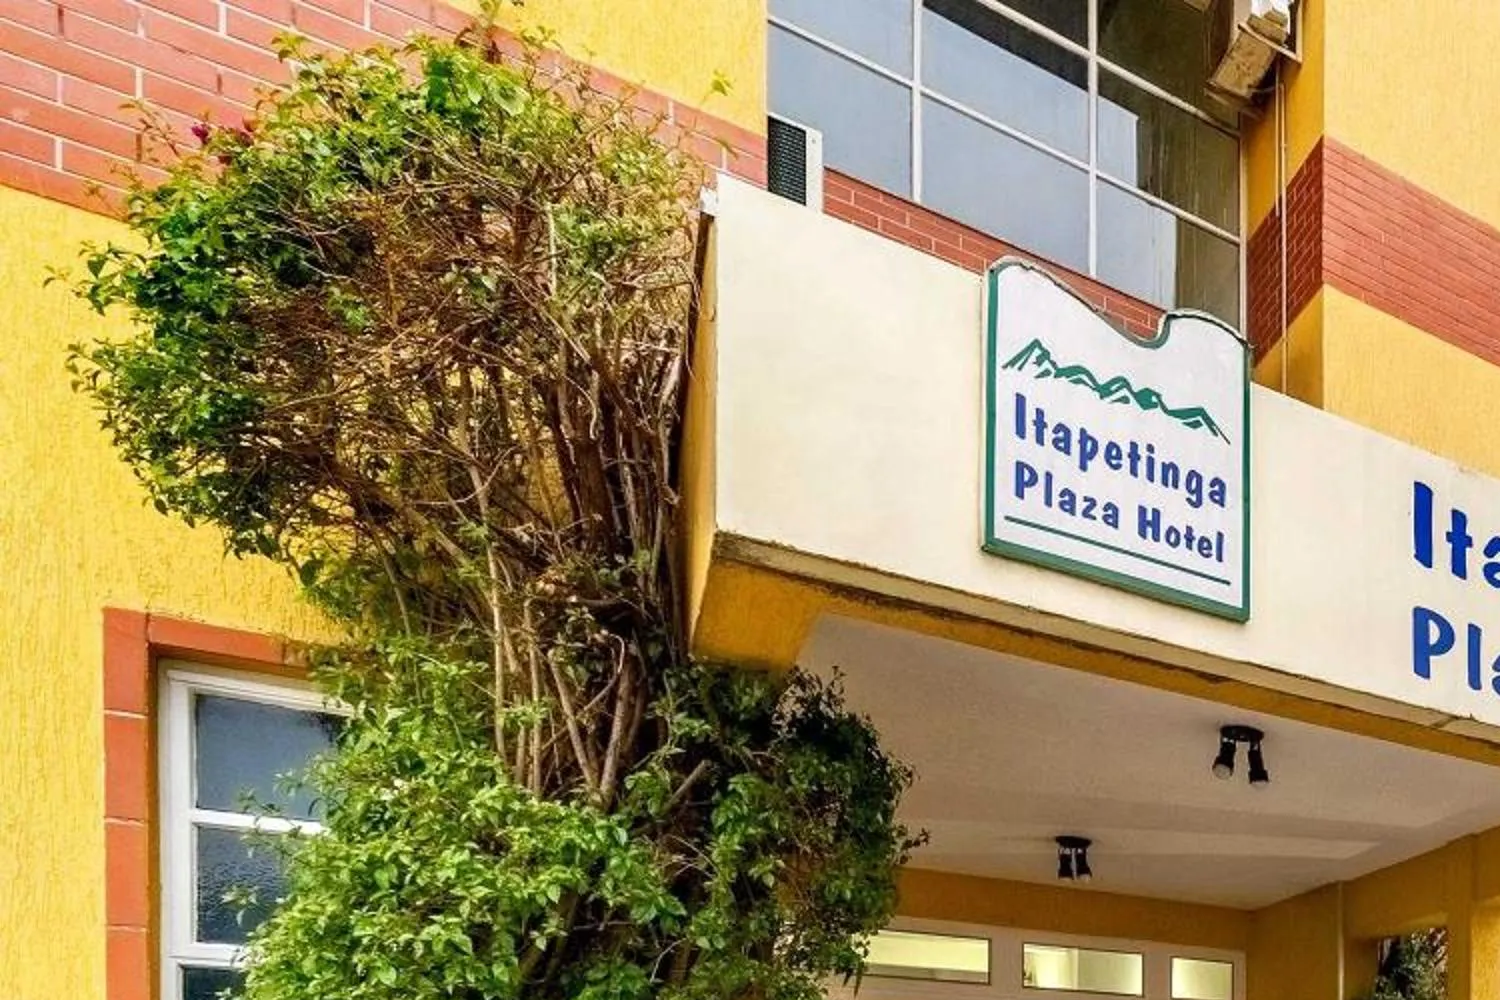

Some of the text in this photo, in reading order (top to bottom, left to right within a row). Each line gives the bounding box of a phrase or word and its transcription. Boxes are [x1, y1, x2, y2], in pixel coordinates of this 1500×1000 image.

[1014, 392, 1228, 509] Itapetinga
[1013, 460, 1225, 562] Plaza Hotel
